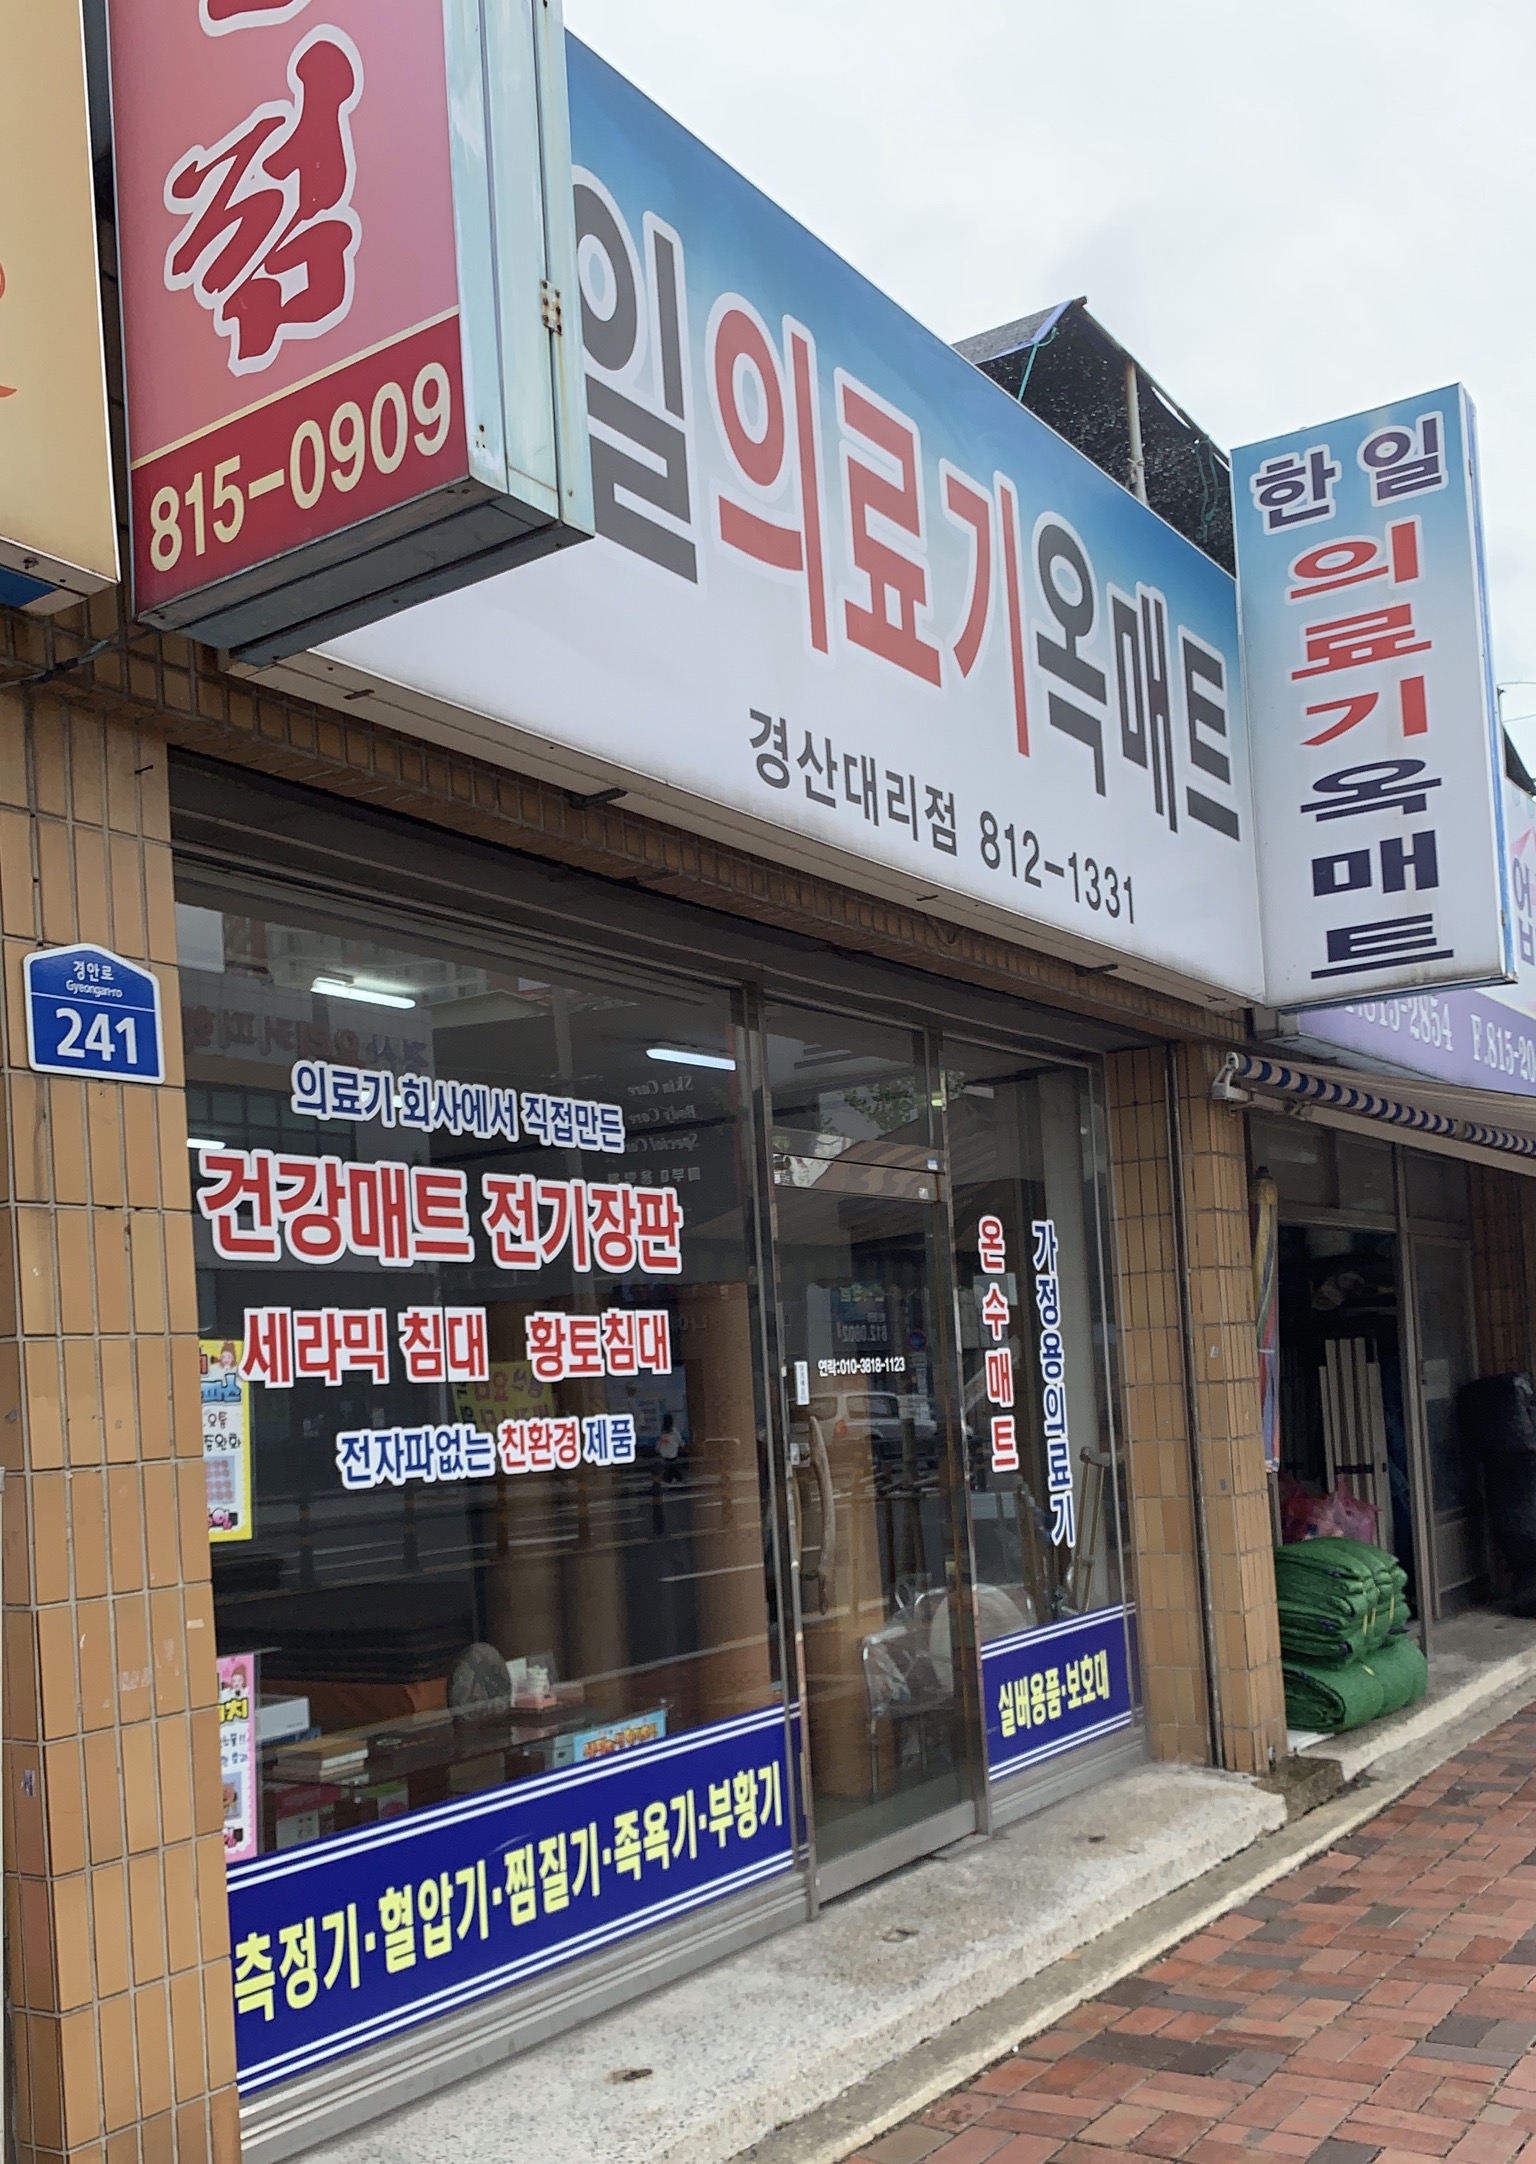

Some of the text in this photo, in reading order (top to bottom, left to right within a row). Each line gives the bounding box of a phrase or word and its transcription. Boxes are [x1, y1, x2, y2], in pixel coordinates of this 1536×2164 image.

[150, 363, 451, 571] 815-0909
[1255, 418, 1443, 529] 한일
[749, 707, 1136, 925] 경산대리점 812-1331
[73, 960, 115, 982] 경안로
[55, 1007, 138, 1065] 241
[294, 1063, 624, 1150] 의료기 회사에서 직접만든
[202, 1153, 684, 1271] 건강매트 전기장판
[241, 1311, 388, 1385] 세라믹
[400, 1310, 486, 1380] 침대
[527, 1309, 670, 1376] 황토침대
[981, 1217, 1017, 1469] 온수매트
[1033, 1221, 1075, 1547] 가정용의료기
[340, 1427, 493, 1487] 전자파없는
[500, 1417, 581, 1470] 친환경
[582, 1415, 635, 1464] 제품
